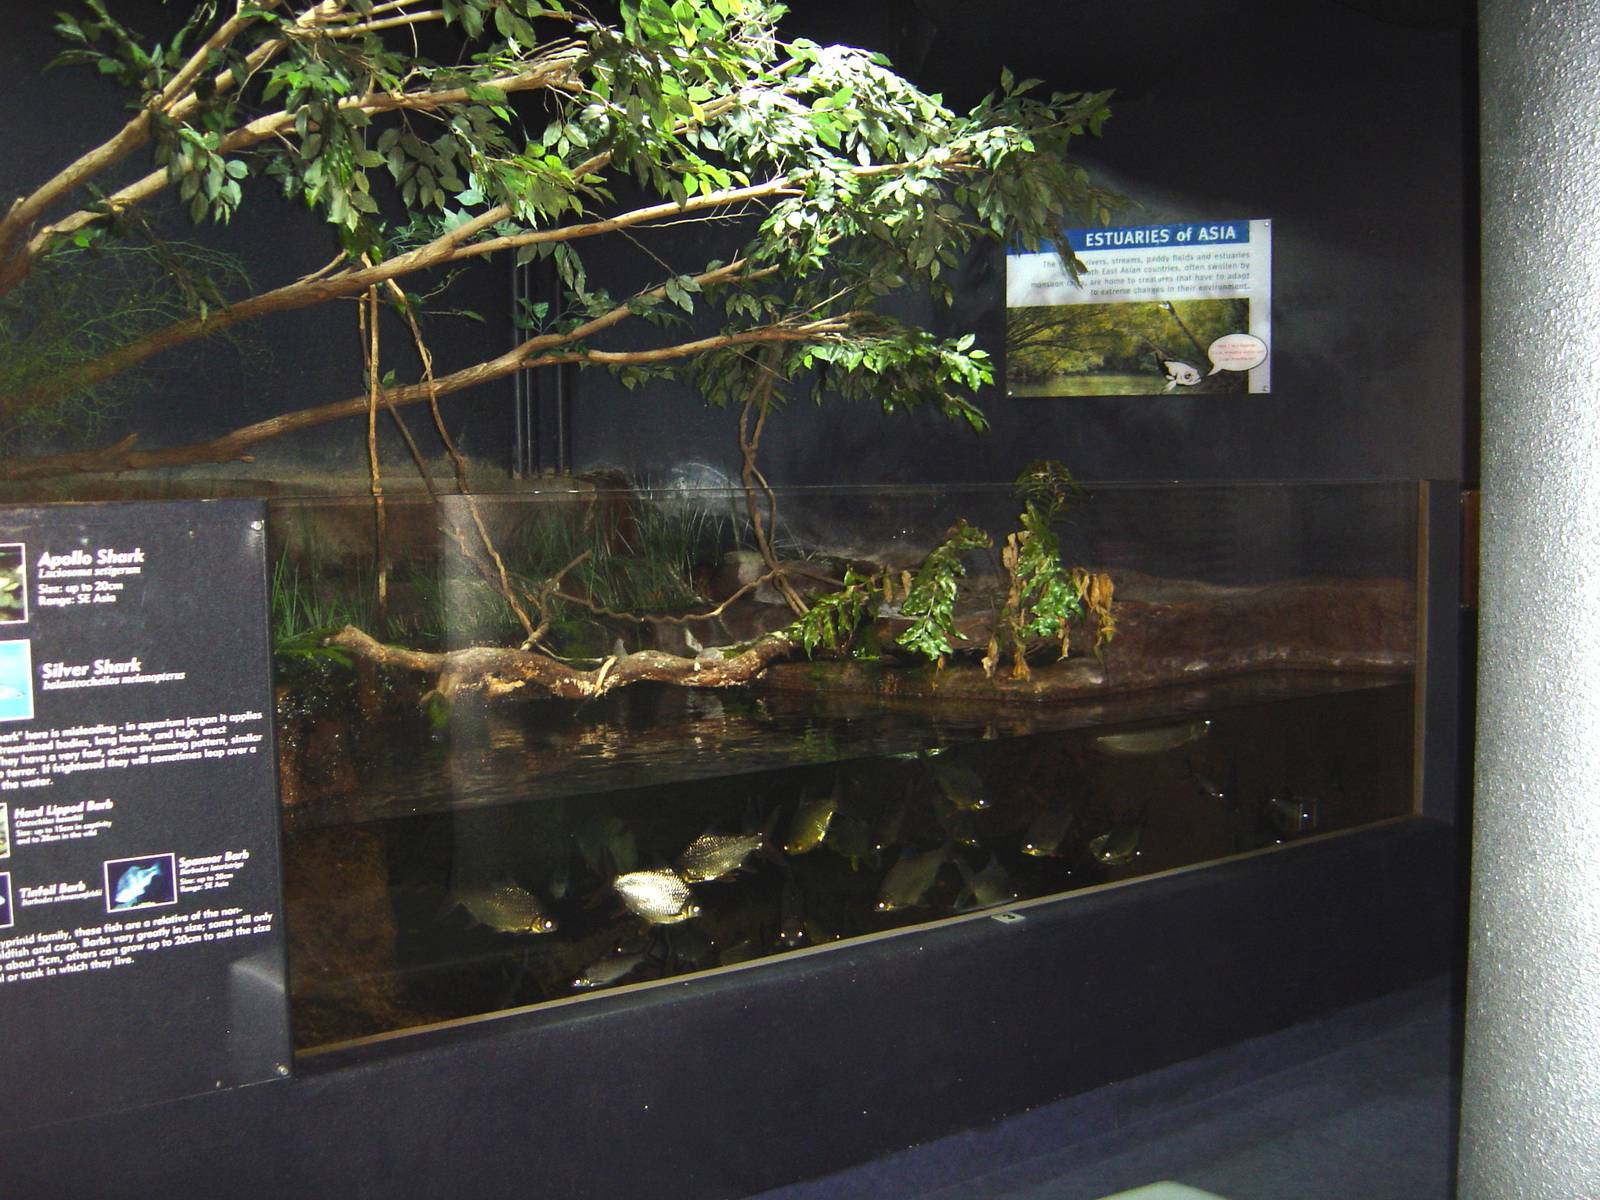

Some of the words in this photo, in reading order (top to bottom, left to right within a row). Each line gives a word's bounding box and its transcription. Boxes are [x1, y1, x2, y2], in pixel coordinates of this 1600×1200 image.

[1085, 229, 1170, 247] ESTUARIES
[1176, 228, 1194, 242] of
[1198, 226, 1237, 241] ASIA
[1112, 256, 1143, 265] streams,
[1146, 255, 1169, 264] paddy
[1214, 251, 1250, 259] estuaries
[1121, 267, 1141, 275] Asian
[1144, 265, 1181, 273] countries,
[1184, 263, 1205, 271] often
[1207, 262, 1238, 270] swollen
[1240, 262, 1250, 270] by
[1227, 272, 1250, 281] adapt
[1133, 287, 1165, 296] changes
[37, 550, 93, 570] Apollo
[96, 547, 145, 565] Shark
[38, 567, 92, 579] Luciosoma
[38, 583, 63, 594] Size:
[65, 585, 79, 595] up
[81, 583, 93, 592] to
[94, 581, 124, 592] 20cm
[38, 595, 75, 607] Range:
[77, 593, 91, 604] SE
[93, 592, 117, 603] Asia
[42, 662, 90, 679] Silver
[94, 657, 142, 675] Shark
[25, 730, 49, 740] here
[50, 728, 60, 738] is
[61, 724, 117, 737] misleading
[125, 722, 136, 731] in
[138, 718, 185, 731] aquarium
[186, 716, 218, 727] jargon
[219, 713, 228, 723] it
[229, 711, 263, 724] applies
[55, 738, 93, 750] bodies,
[94, 735, 117, 747] long
[119, 731, 152, 744] heads,
[154, 729, 173, 740] and
[175, 727, 200, 739] high,
[202, 726, 227, 735] erect
[21, 754, 47, 764] have
[48, 754, 56, 762] a
[58, 751, 80, 761] very
[81, 748, 105, 758] fast,
[107, 745, 138, 756] active
[140, 740, 189, 753] swimming
[190, 737, 228, 750] pattern,
[231, 733, 263, 744] similar
[6, 767, 40, 778] terror.
[52, 759, 105, 774] frightened
[106, 758, 129, 768] they
[131, 754, 148, 765] will
[150, 751, 202, 763] sometimes
[204, 748, 225, 759] leap
[227, 746, 248, 755] over
[1, 780, 19, 790] the
[21, 778, 54, 788] water.
[14, 804, 44, 819] Hard
[45, 801, 84, 818] Lipped
[86, 798, 114, 812] Barb
[16, 837, 31, 845] and
[69, 831, 82, 839] the
[34, 828, 44, 836] up
[179, 855, 222, 869] Spanner
[224, 849, 250, 861] Barb
[19, 883, 57, 898] Tinfoil
[58, 880, 87, 894] Barb
[32, 943, 52, 955] and
[54, 941, 80, 952] carp.
[82, 936, 111, 948] Barbs
[113, 934, 134, 944] vary
[136, 926, 170, 941] greatly
[172, 925, 182, 935] in
[184, 922, 205, 933] size;
[208, 919, 233, 929] some
[235, 914, 251, 924] will
[253, 912, 273, 922] only
[37, 930, 72, 944] family,
[74, 926, 102, 937] these
[104, 922, 123, 933] fish
[125, 921, 141, 930] are
[143, 920, 151, 928] a
[152, 914, 189, 926] relative
[190, 910, 202, 920] of
[203, 908, 219, 919] the
[221, 907, 243, 916] non-
[5, 958, 35, 970] about
[37, 955, 63, 966] 5cm,
[66, 950, 97, 962] others
[99, 947, 118, 957] can
[120, 943, 146, 955] grow
[146, 940, 160, 951] up
[161, 938, 173, 947] to
[174, 934, 202, 946] 20cm
[203, 932, 214, 941] to
[216, 929, 233, 939] suit
[235, 926, 251, 936] the
[253, 924, 271, 934] size
[7, 973, 18, 982] or
[21, 968, 44, 980] tank
[46, 966, 56, 976] in
[59, 962, 88, 973] which
[90, 959, 112, 970] they
[114, 956, 134, 966] live.
